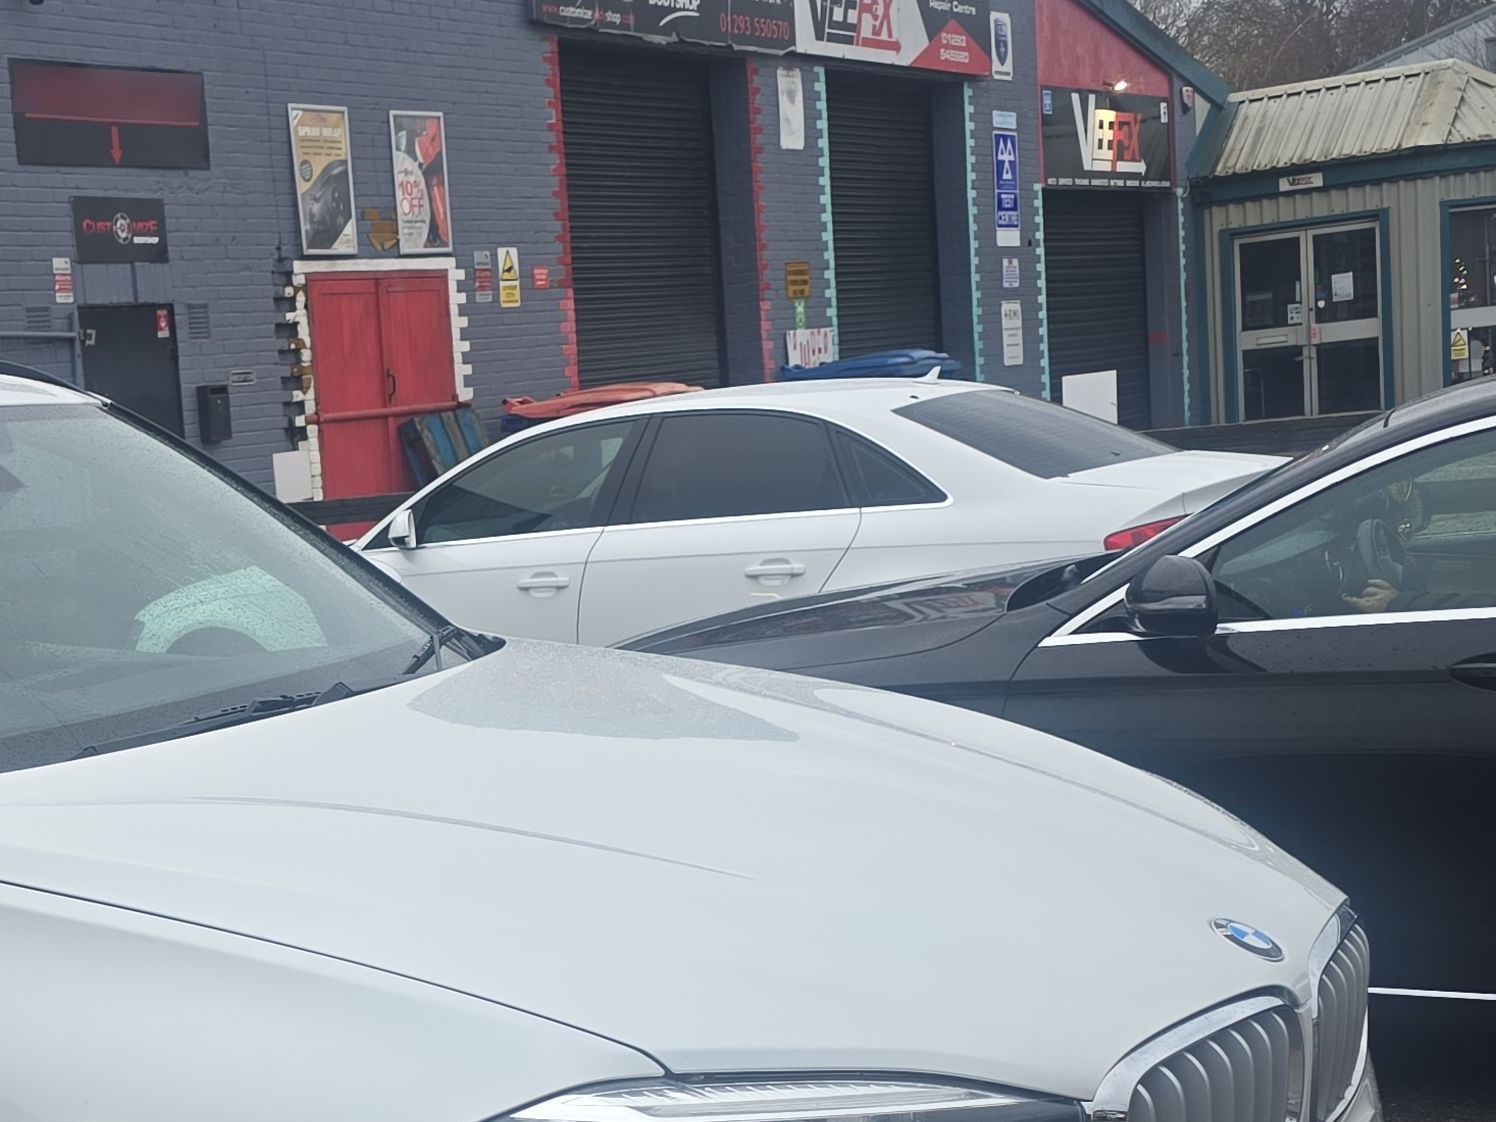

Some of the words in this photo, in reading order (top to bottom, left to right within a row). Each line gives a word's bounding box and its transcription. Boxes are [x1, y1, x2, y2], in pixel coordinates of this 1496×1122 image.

[719, 12, 751, 35] 01293
[754, 17, 790, 40] 550570
[297, 126, 321, 137] SPRAY
[400, 197, 424, 216] OFF
